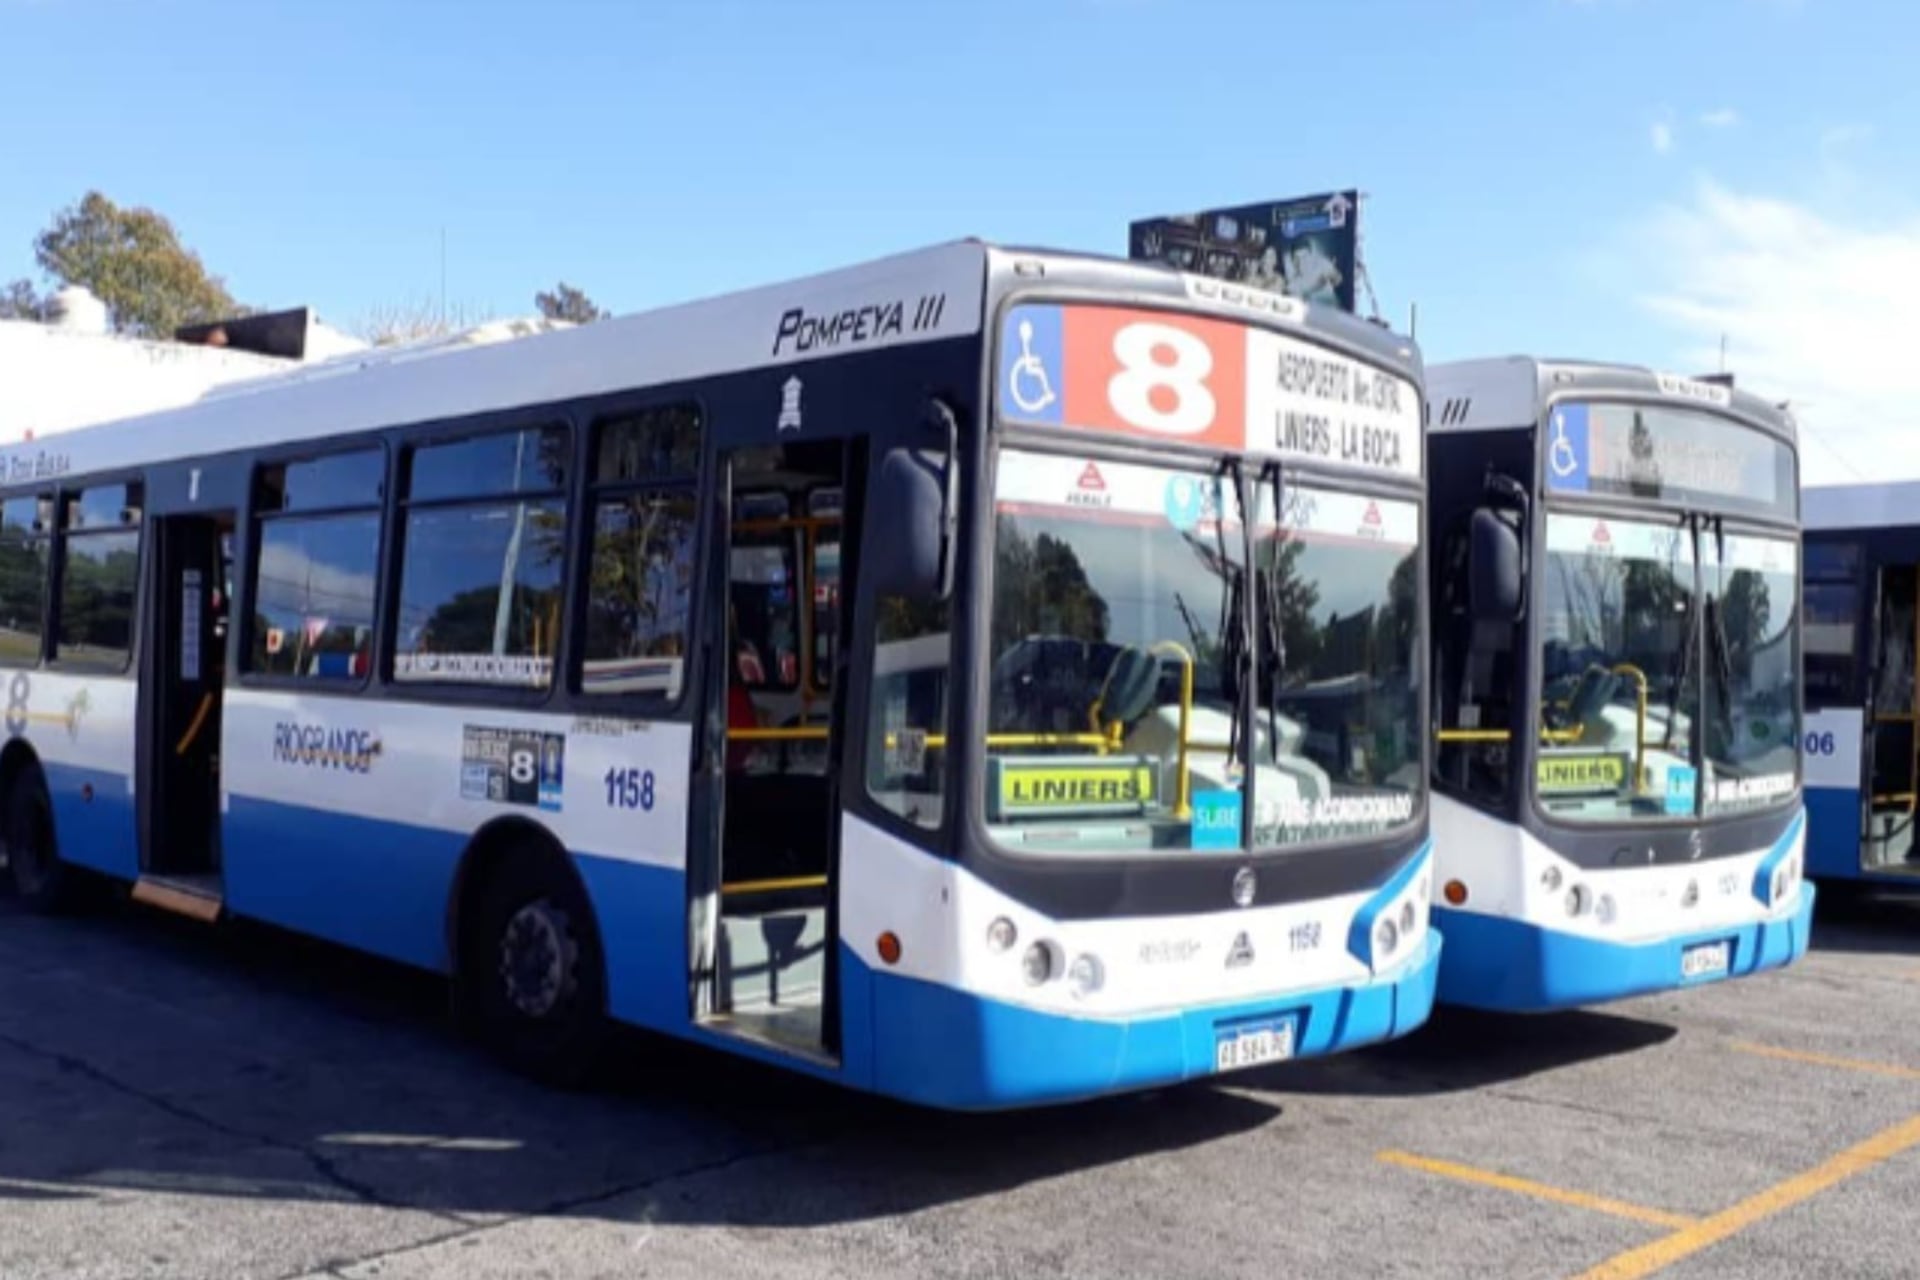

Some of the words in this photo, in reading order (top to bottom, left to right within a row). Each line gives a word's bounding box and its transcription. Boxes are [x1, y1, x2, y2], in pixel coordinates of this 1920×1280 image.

[1108, 321, 1216, 434] 8
[1275, 409, 1331, 456] LINIERS
[1341, 418, 1358, 460] LA
[1362, 424, 1401, 467] BOCA
[6, 671, 31, 737] 8
[1805, 732, 1835, 756] 06
[510, 748, 535, 784] 8
[604, 765, 656, 811] 1158
[1013, 778, 1141, 800] LINIERS
[1195, 804, 1239, 830] SUBE
